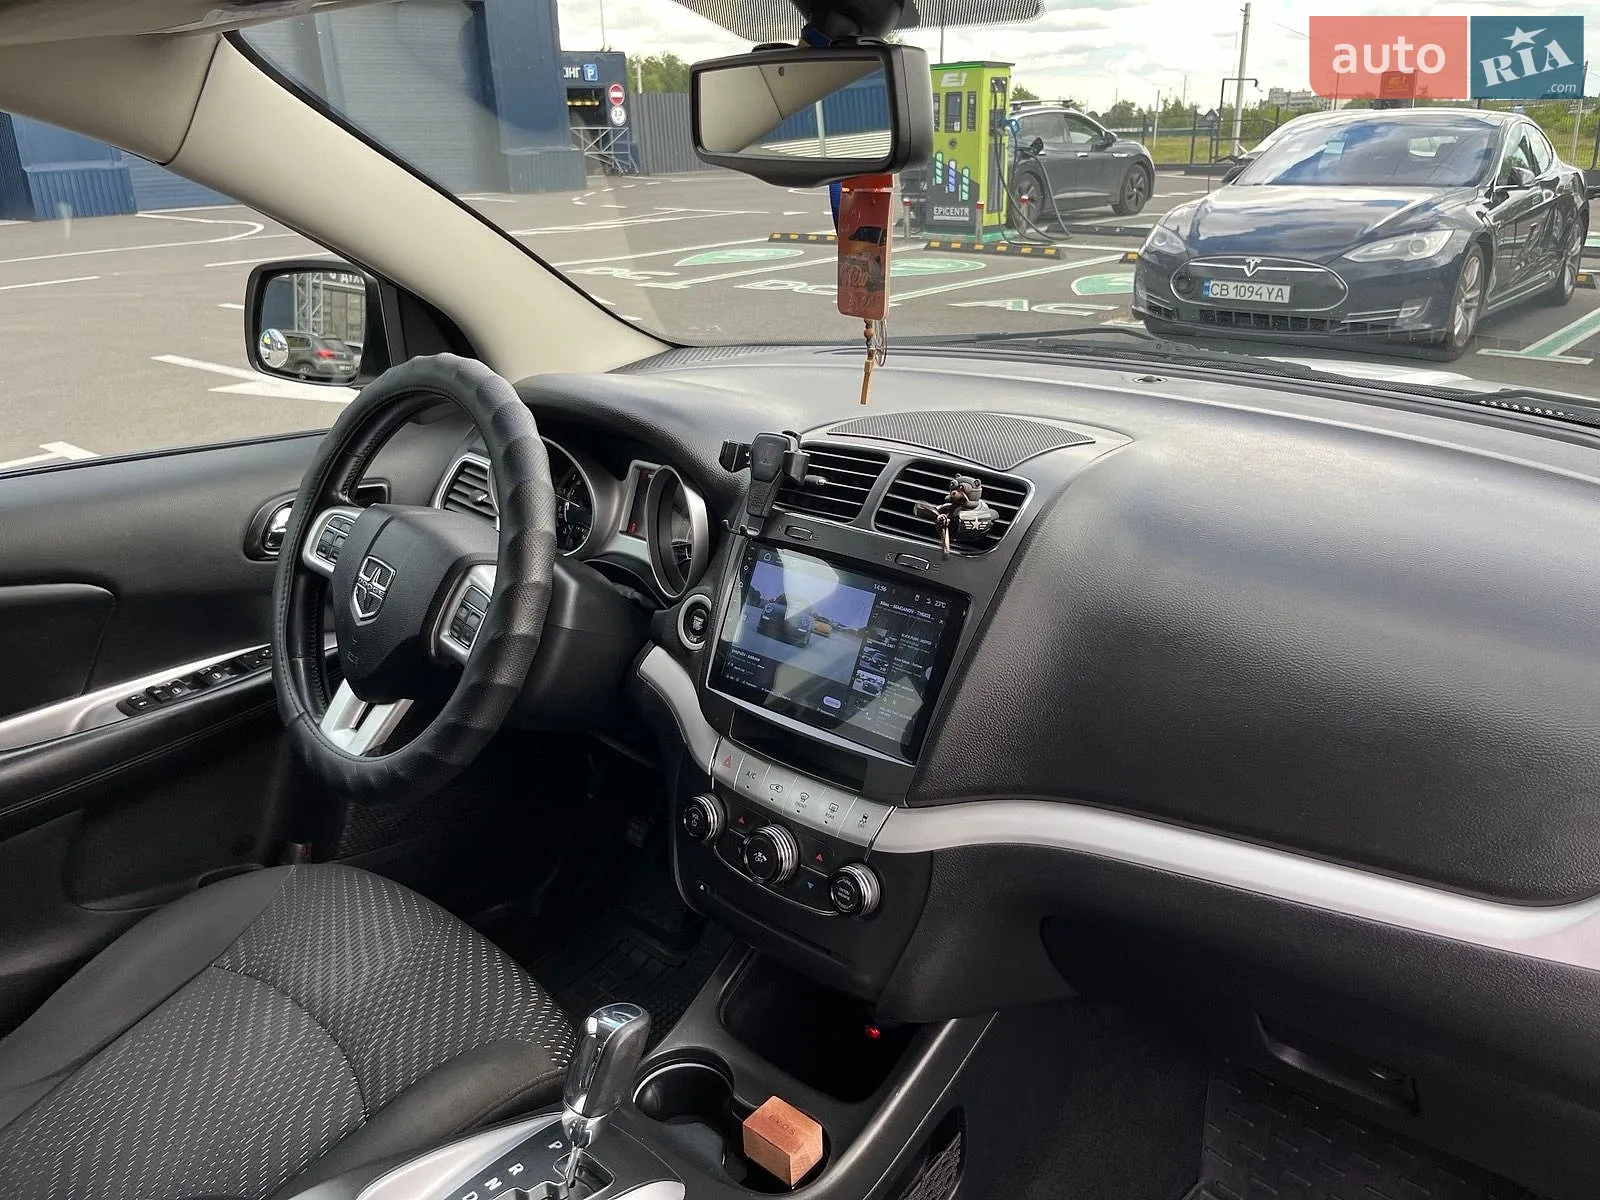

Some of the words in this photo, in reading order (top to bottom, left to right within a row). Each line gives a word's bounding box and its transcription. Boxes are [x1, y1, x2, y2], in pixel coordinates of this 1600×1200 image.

[933, 206, 970, 216] EPICENTR
[1210, 282, 1229, 297] CB
[1232, 284, 1263, 299] 1094
[1266, 287, 1284, 301] YA
[358, 577, 385, 597] DODGE
[745, 770, 757, 780] A/C
[547, 1140, 563, 1149] P
[508, 1162, 524, 1176] R
[484, 1176, 503, 1191] N
